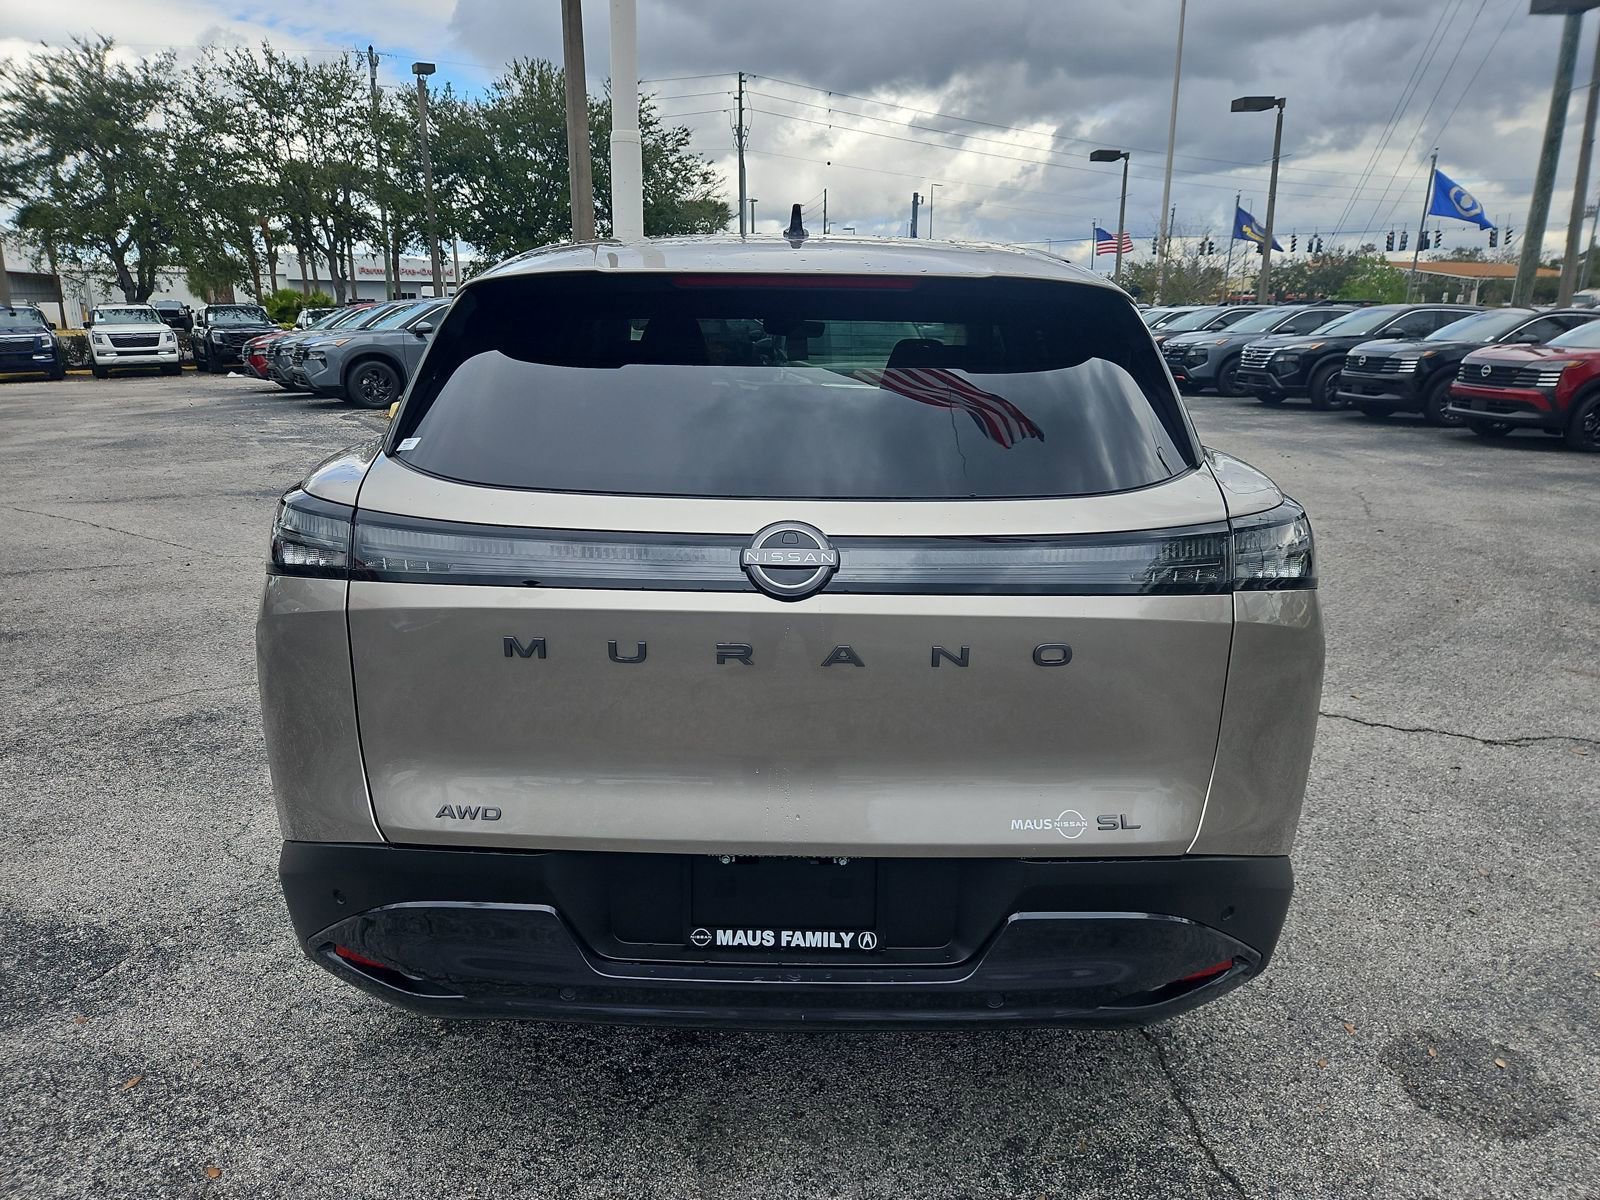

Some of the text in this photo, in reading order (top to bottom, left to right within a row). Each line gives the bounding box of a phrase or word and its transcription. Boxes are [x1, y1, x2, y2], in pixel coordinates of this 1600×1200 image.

[746, 552, 834, 563] NISSAN
[503, 635, 1073, 667] MURANO
[435, 804, 502, 821] AWD
[1010, 818, 1088, 830] MAUS NISSAN
[1097, 813, 1142, 831] SL
[716, 930, 775, 946] MAUS
[781, 931, 854, 948] FAMILY
